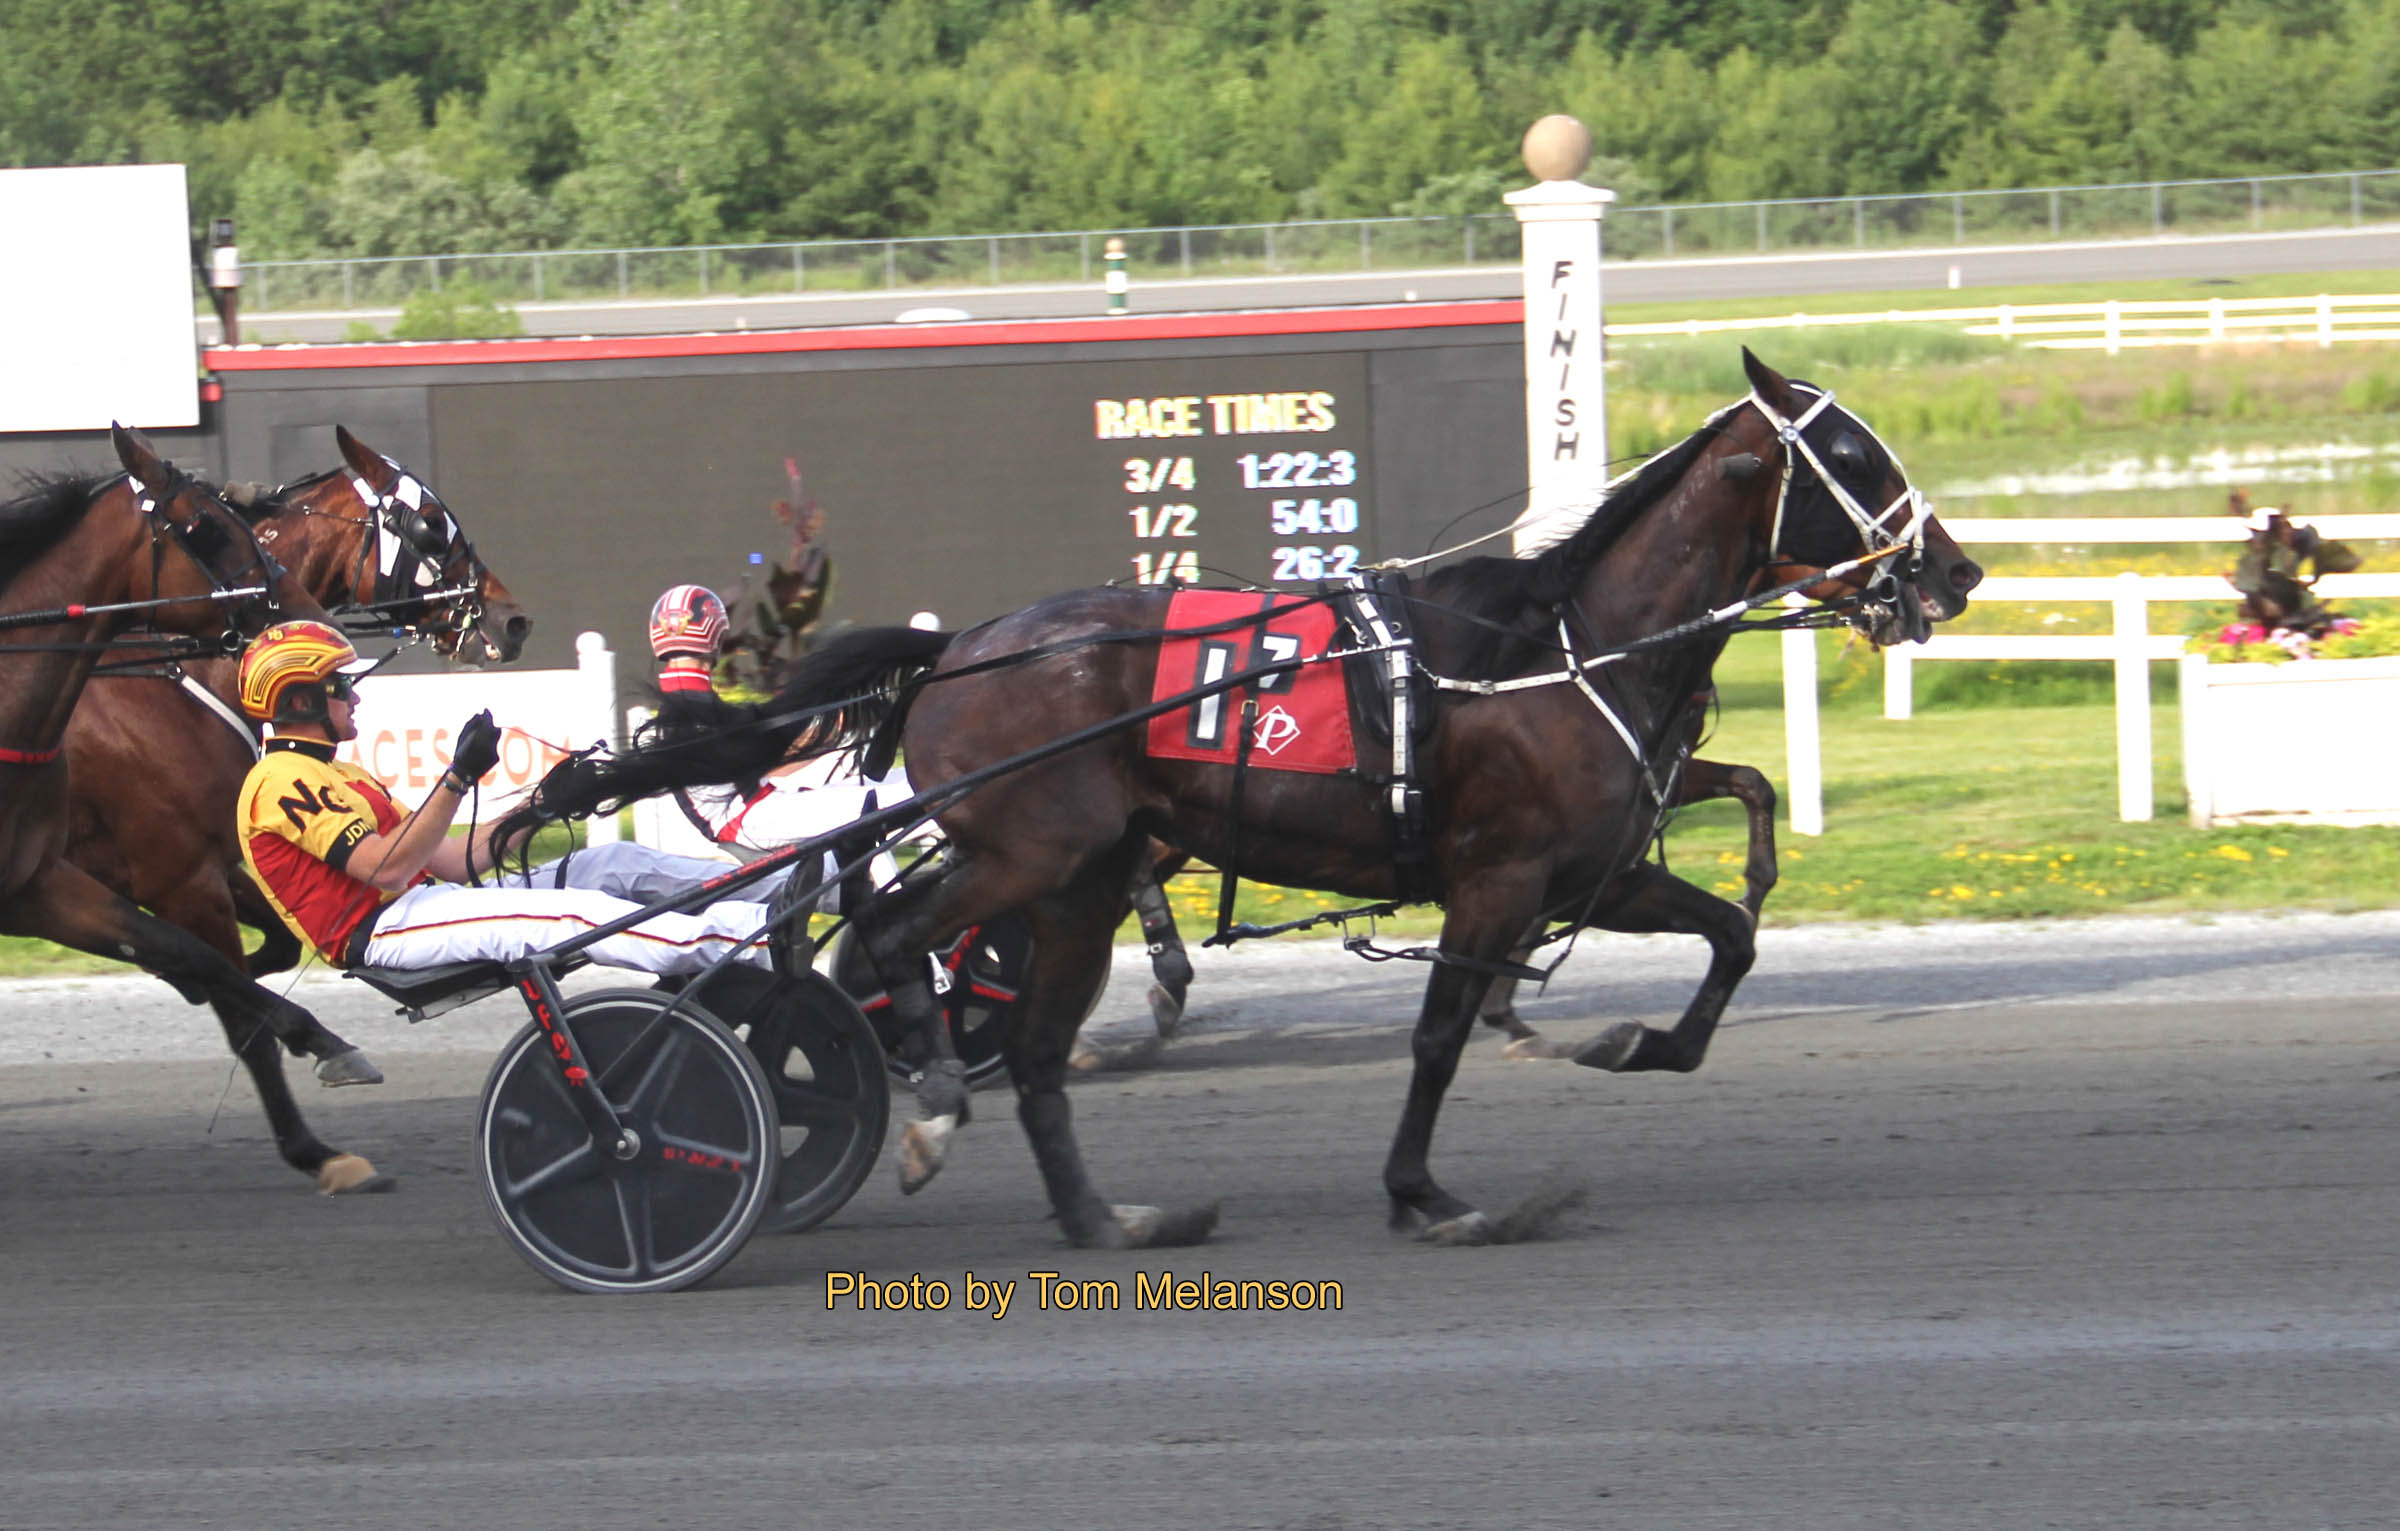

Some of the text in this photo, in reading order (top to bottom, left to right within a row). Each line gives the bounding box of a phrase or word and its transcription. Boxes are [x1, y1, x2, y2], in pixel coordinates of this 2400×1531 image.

[1550, 260, 1580, 461] FINISH
[1095, 391, 1336, 438] RACE TIMES
[1123, 450, 1356, 493] 3/4 1:22:3
[1129, 498, 1359, 538] 1/2 54:0
[1131, 544, 1360, 585] 1/4 26:2
[278, 778, 354, 835] NC
